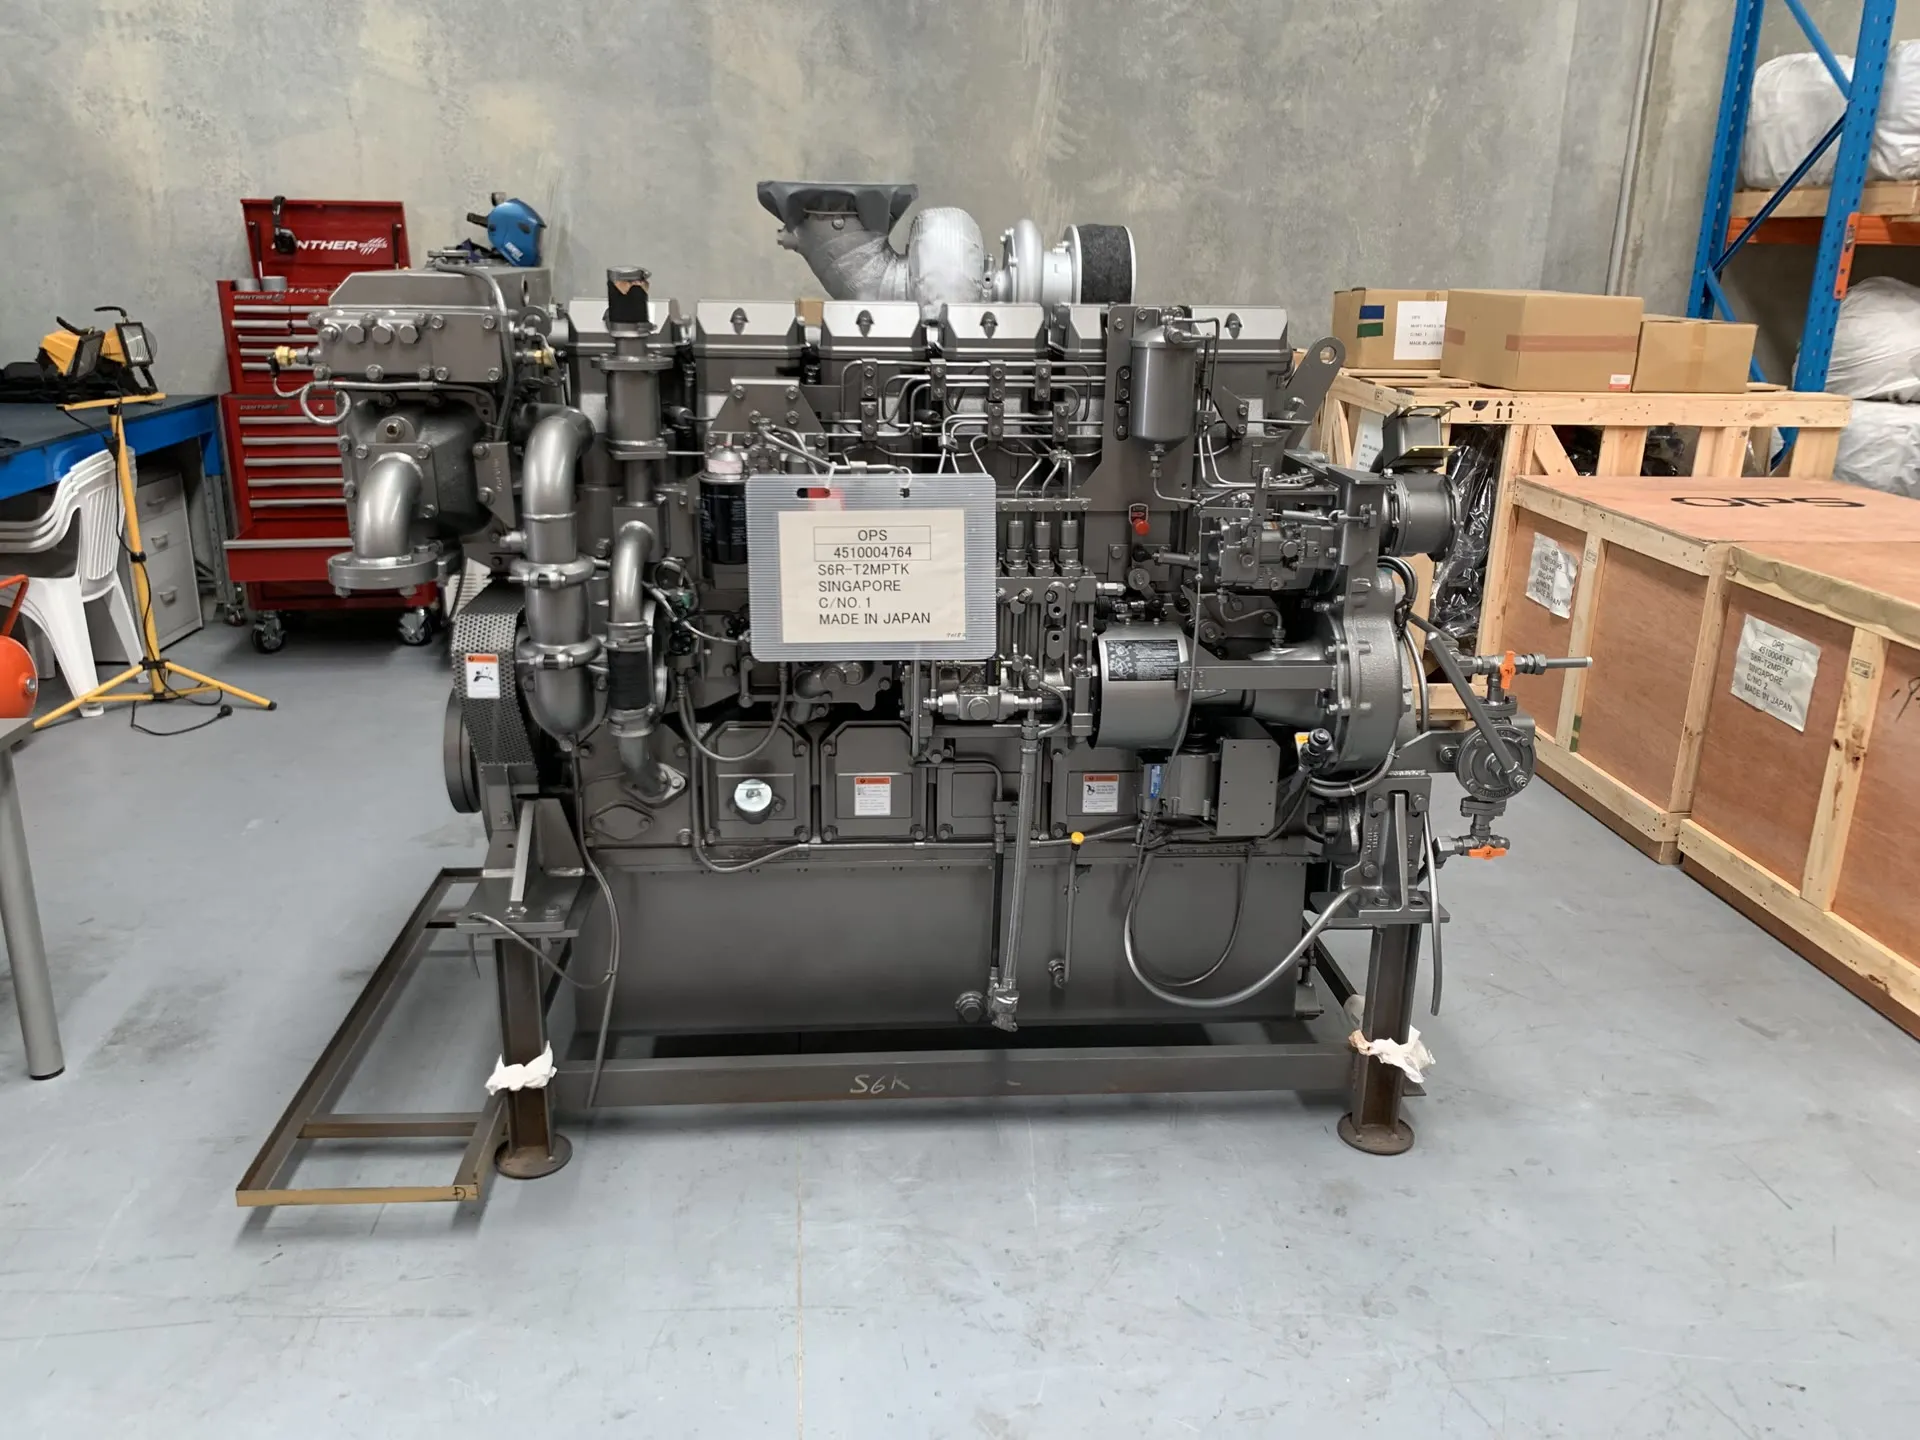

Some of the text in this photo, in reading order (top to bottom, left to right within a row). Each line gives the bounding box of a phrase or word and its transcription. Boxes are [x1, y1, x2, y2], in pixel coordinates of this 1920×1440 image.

[271, 240, 359, 251] NTHER
[1670, 496, 1866, 508] OPS
[857, 530, 888, 542] OPS
[833, 546, 912, 559] 4510004764
[818, 563, 910, 576] S6R-T2MPTK
[818, 580, 901, 593] SINGAPORE
[818, 612, 931, 625] MADE IN JAPAN
[1771, 639, 1785, 651] OPS
[1748, 662, 1784, 686] SINGAPORE
[1744, 683, 1793, 713] MADE IN JAPAN
